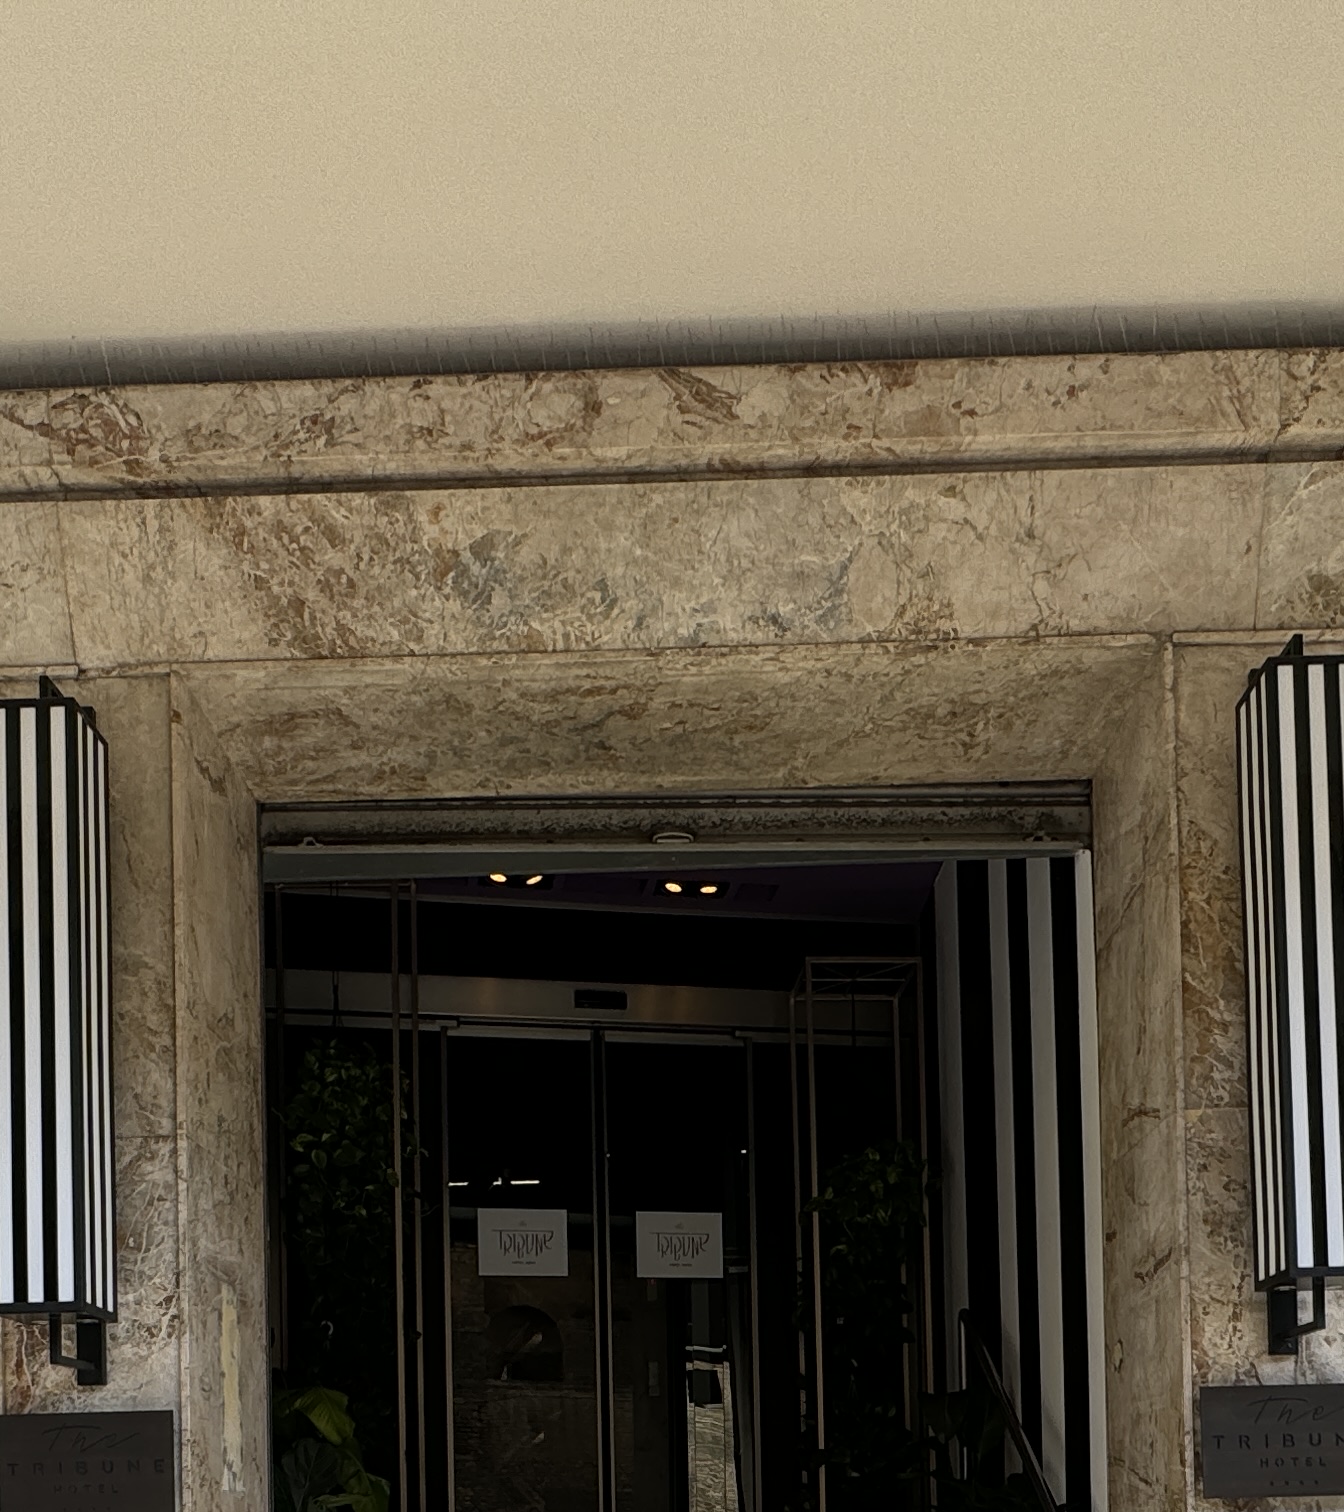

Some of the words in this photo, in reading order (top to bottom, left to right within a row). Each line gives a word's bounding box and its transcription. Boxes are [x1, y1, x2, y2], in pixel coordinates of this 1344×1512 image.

[492, 1229, 554, 1259] TRIBUNE
[649, 1231, 710, 1262] TRIBUNE
[41, 1422, 141, 1453] The
[7, 1458, 165, 1477] TRIBUNE
[1259, 1456, 1327, 1469] HOTEL
[54, 1483, 119, 1495] HOTEL
